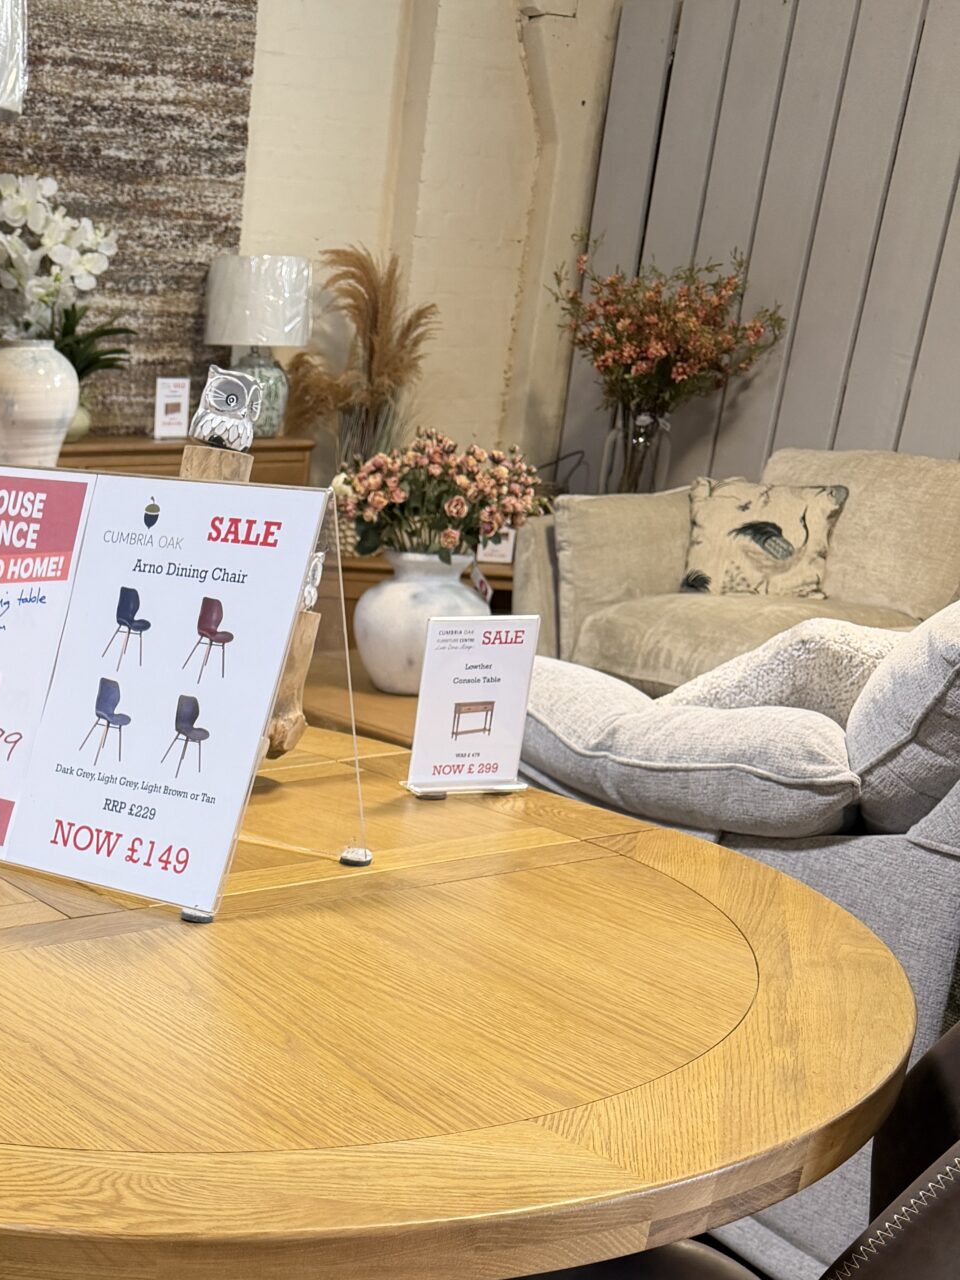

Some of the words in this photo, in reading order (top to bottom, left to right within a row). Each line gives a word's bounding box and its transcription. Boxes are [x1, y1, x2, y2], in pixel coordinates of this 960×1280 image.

[103, 529, 154, 547] CUMBRIA
[158, 535, 184, 550] OAK
[207, 515, 282, 548] SALE
[6, 556, 65, 580] HOME!
[132, 558, 163, 575] Arno
[165, 562, 208, 583] Dining
[211, 567, 248, 584] Chair
[17, 587, 47, 605] table
[481, 629, 525, 646] SALE
[465, 663, 492, 671] Lowther
[452, 676, 481, 685] Console
[482, 676, 502, 684] Table
[432, 763, 465, 776] NOW
[467, 763, 475, 774] £
[477, 762, 499, 774] 299
[55, 763, 75, 776] Dark
[76, 768, 96, 782] Grey,
[97, 772, 118, 785] Light
[119, 777, 140, 791] Grey,
[141, 780, 162, 794] Light
[162, 786, 189, 800] Brown
[190, 792, 200, 801] or
[201, 792, 216, 805] Tan
[102, 798, 127, 814] RRP
[127, 803, 157, 820] £229
[50, 819, 123, 858] NOW
[125, 837, 190, 874] £149
